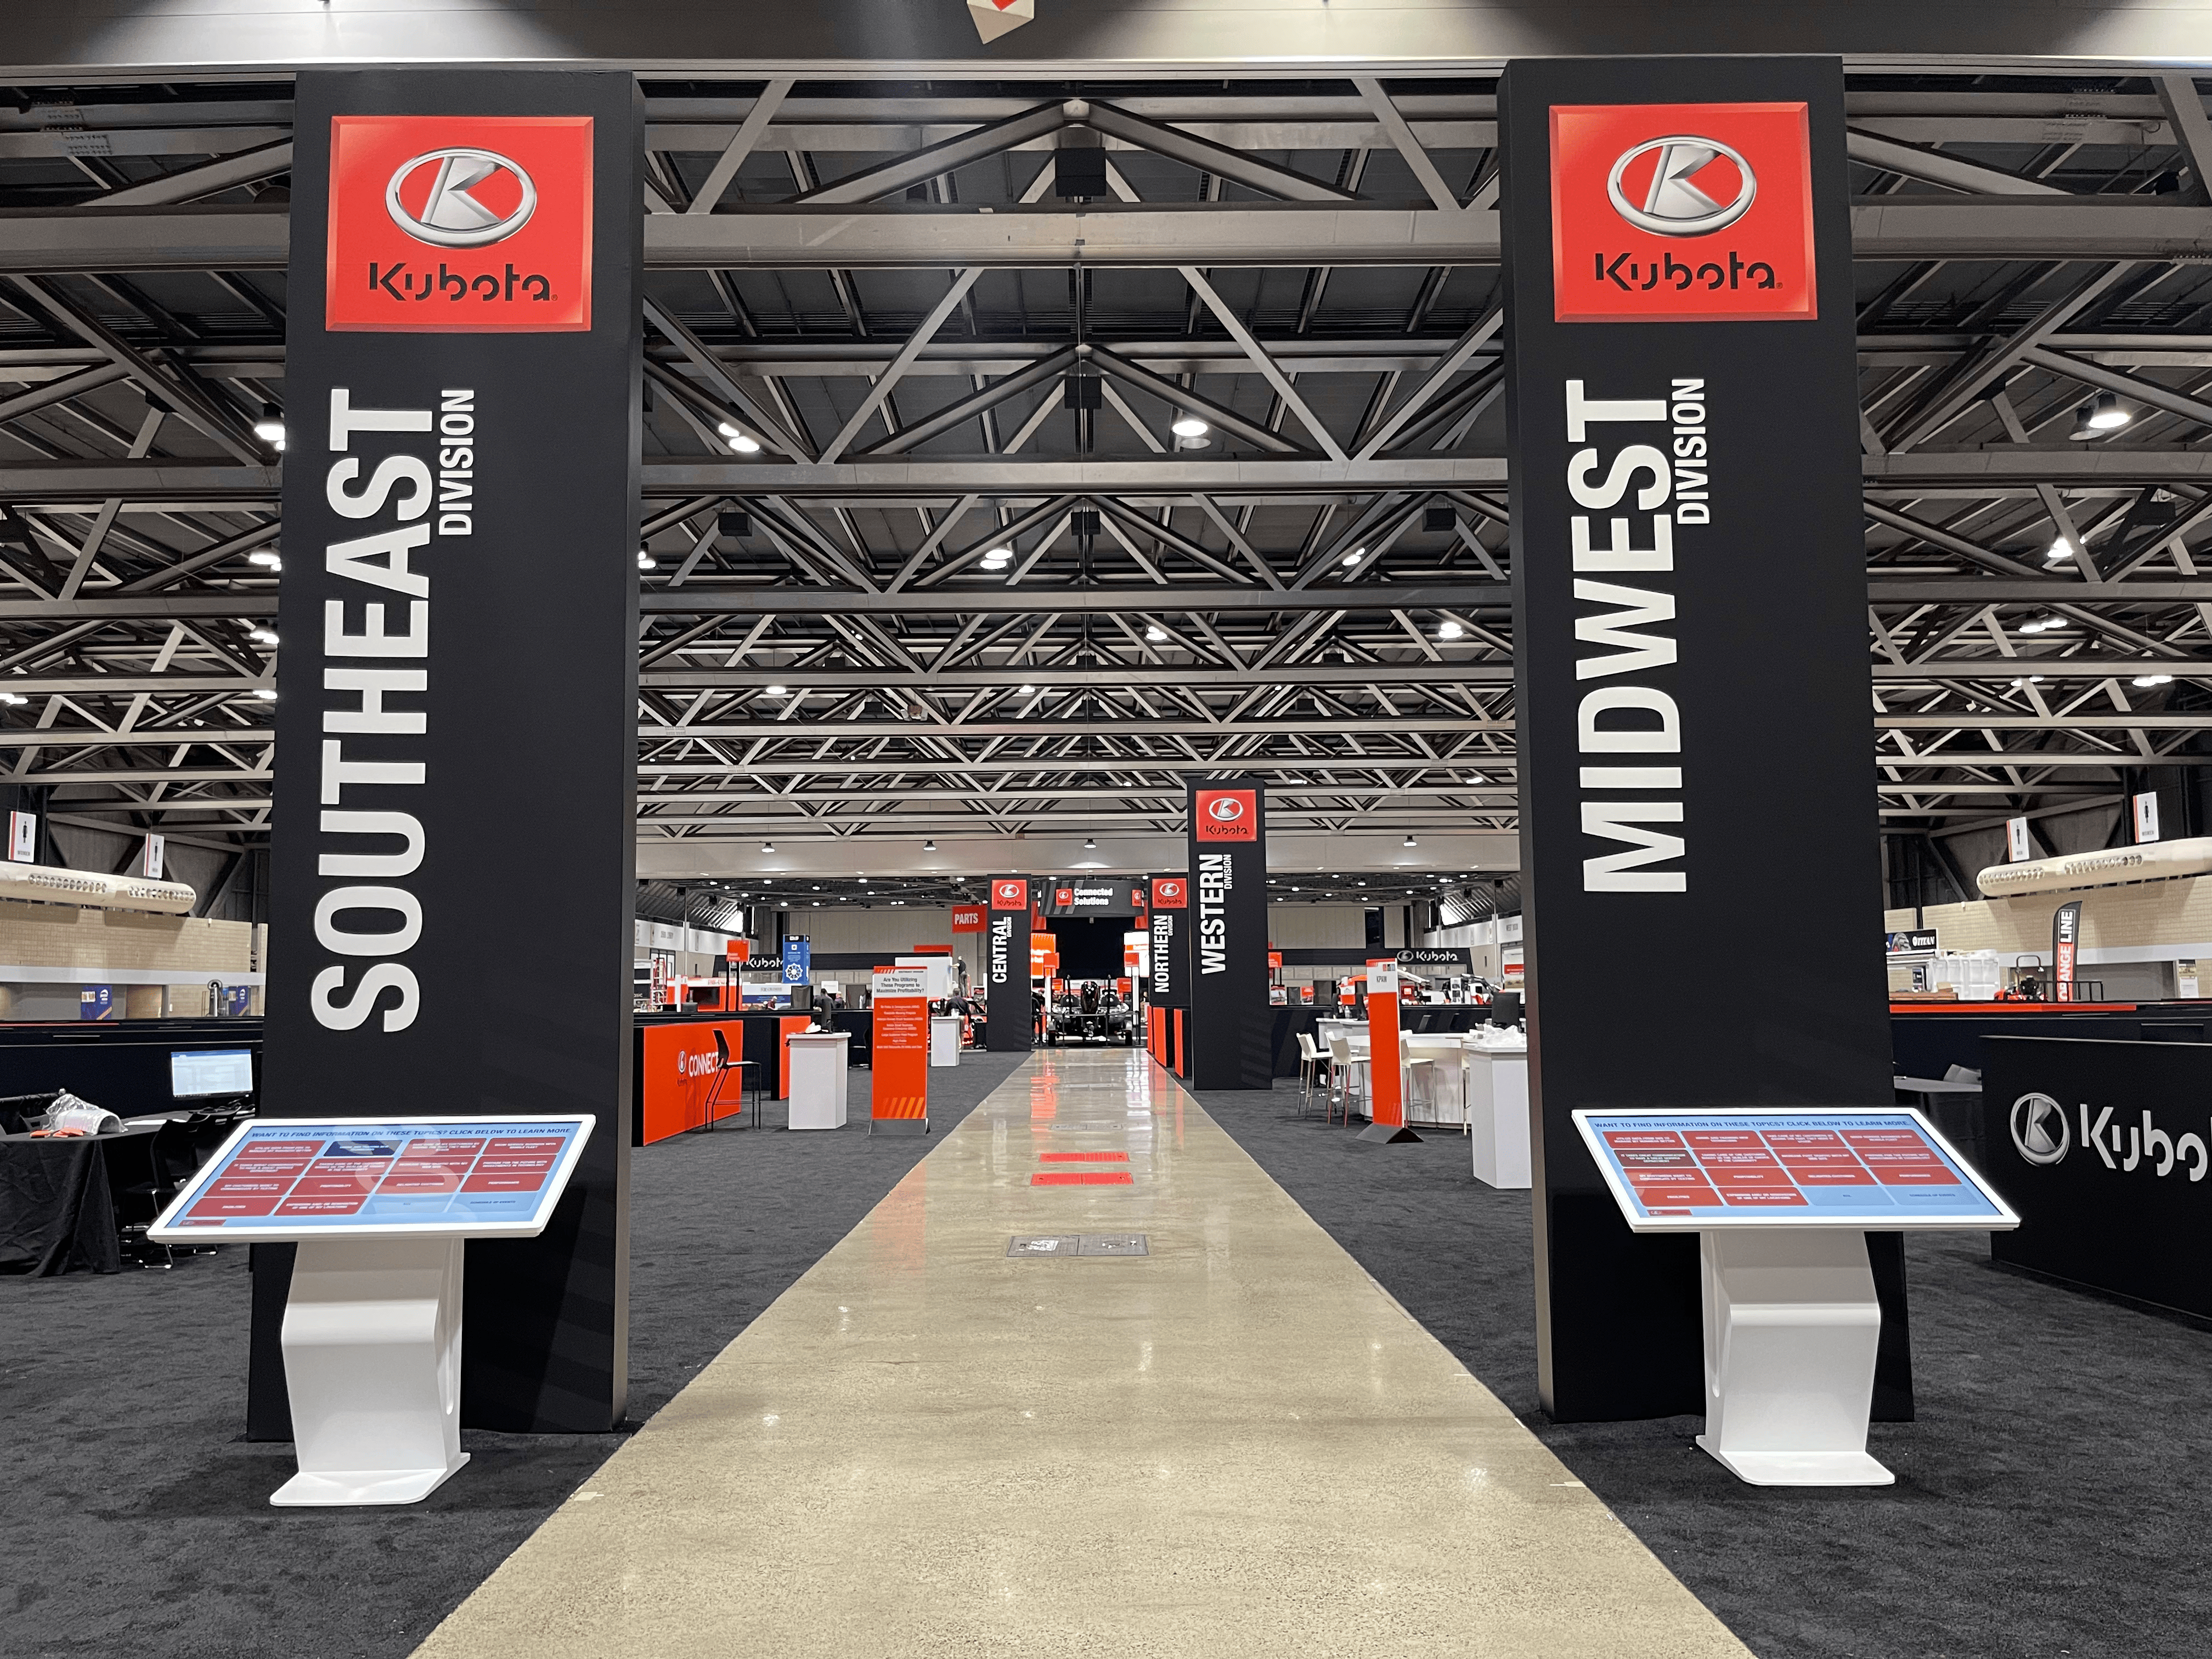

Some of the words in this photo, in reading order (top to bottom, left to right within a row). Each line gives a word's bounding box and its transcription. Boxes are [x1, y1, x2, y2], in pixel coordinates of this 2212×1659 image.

[369, 262, 551, 302] Kubota
[1595, 251, 1776, 292] Kubota
[438, 389, 475, 535] DIVISION
[1671, 378, 1710, 524] DIVISION
[1566, 379, 1686, 892] MIDWEST
[311, 388, 433, 1032] SOUTHEAST
[1206, 825, 1248, 835] Kubota
[1074, 888, 1113, 896] Connected
[1223, 854, 1233, 890] DIVISION
[955, 912, 978, 924] PARTS
[1074, 897, 1109, 905] Solutions
[1199, 854, 1226, 974] WESTERN
[2060, 911, 2073, 943] LINE
[992, 916, 1007, 984] CENTRAL
[1153, 915, 1170, 993] NORTHERN
[1416, 951, 1459, 961] Kubota
[689, 1051, 719, 1077] CONNECT
[2080, 1103, 2212, 1182] Kubo
